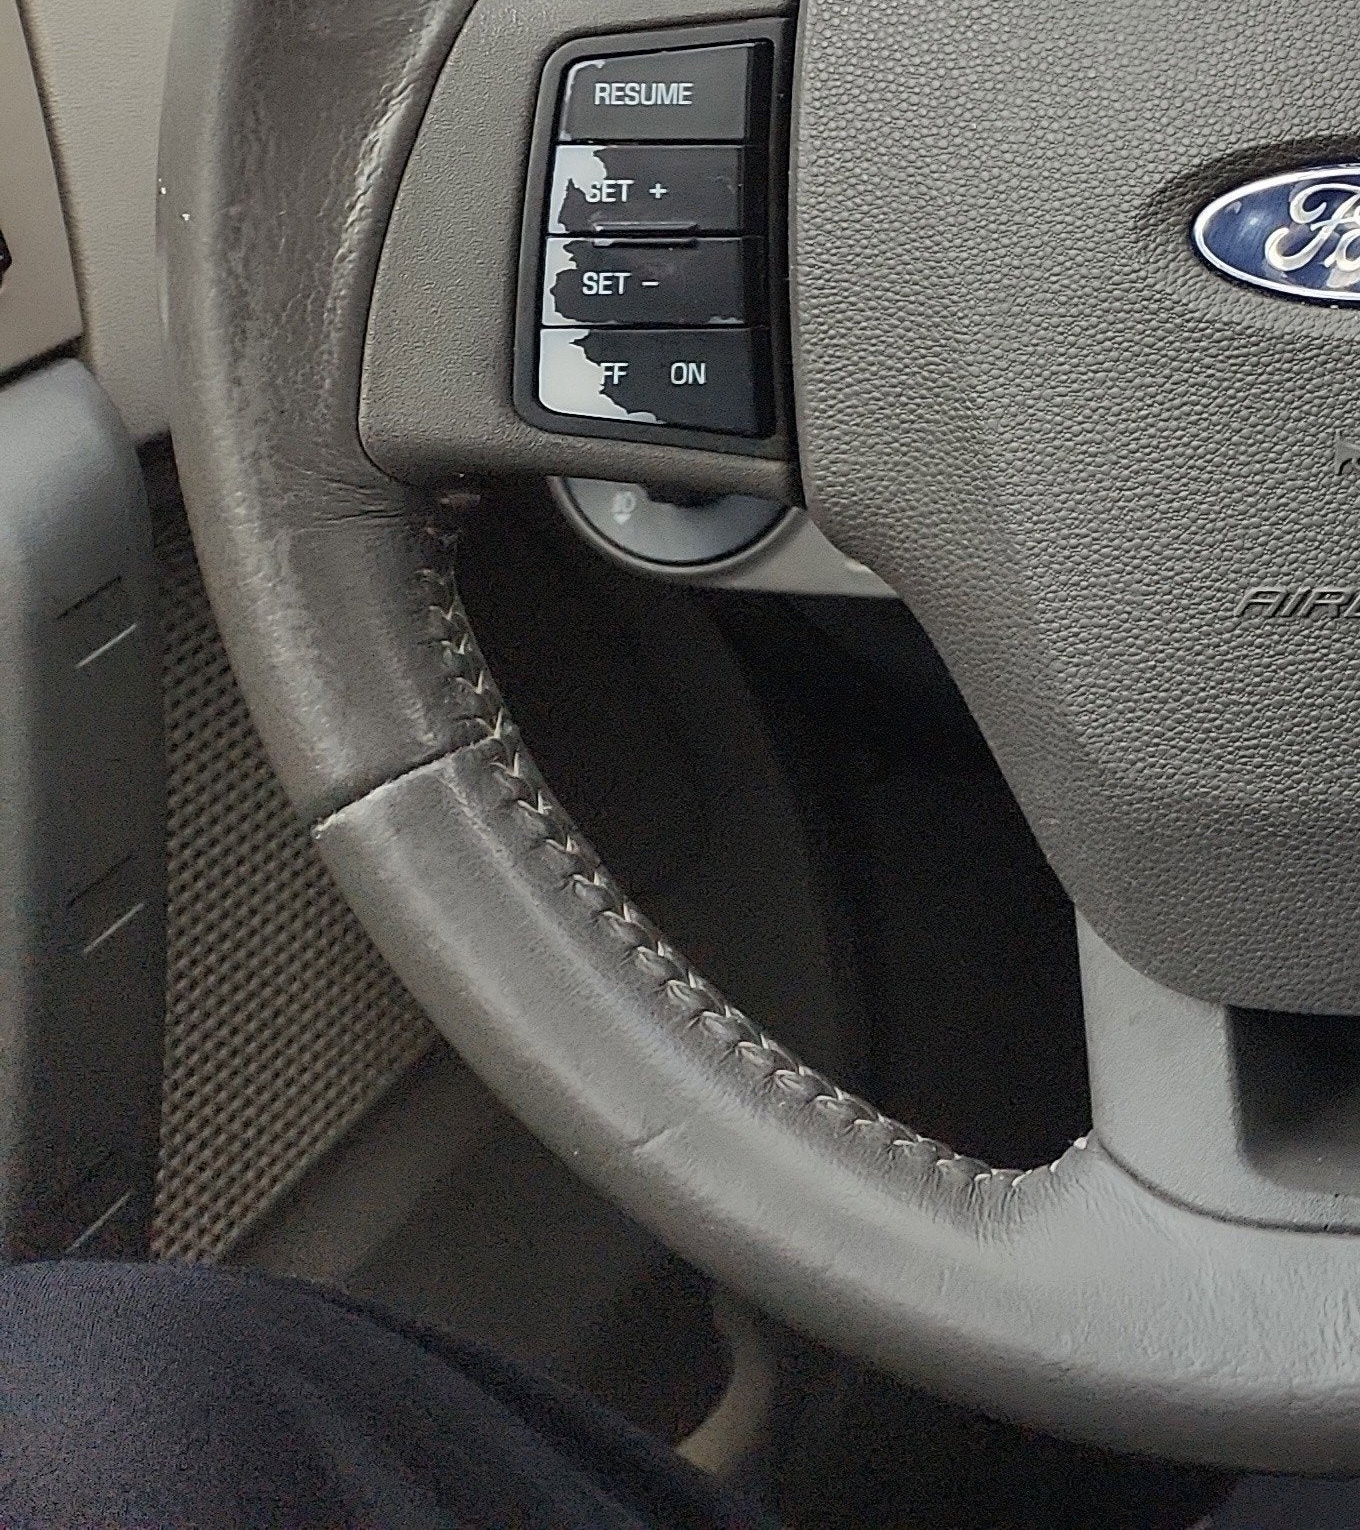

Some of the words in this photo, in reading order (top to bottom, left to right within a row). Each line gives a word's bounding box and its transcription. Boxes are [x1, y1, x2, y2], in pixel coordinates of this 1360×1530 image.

[594, 82, 695, 106] RESUME
[585, 179, 635, 203] SET
[582, 272, 632, 295] SET
[594, 362, 629, 386] FF
[670, 362, 707, 386] ON
